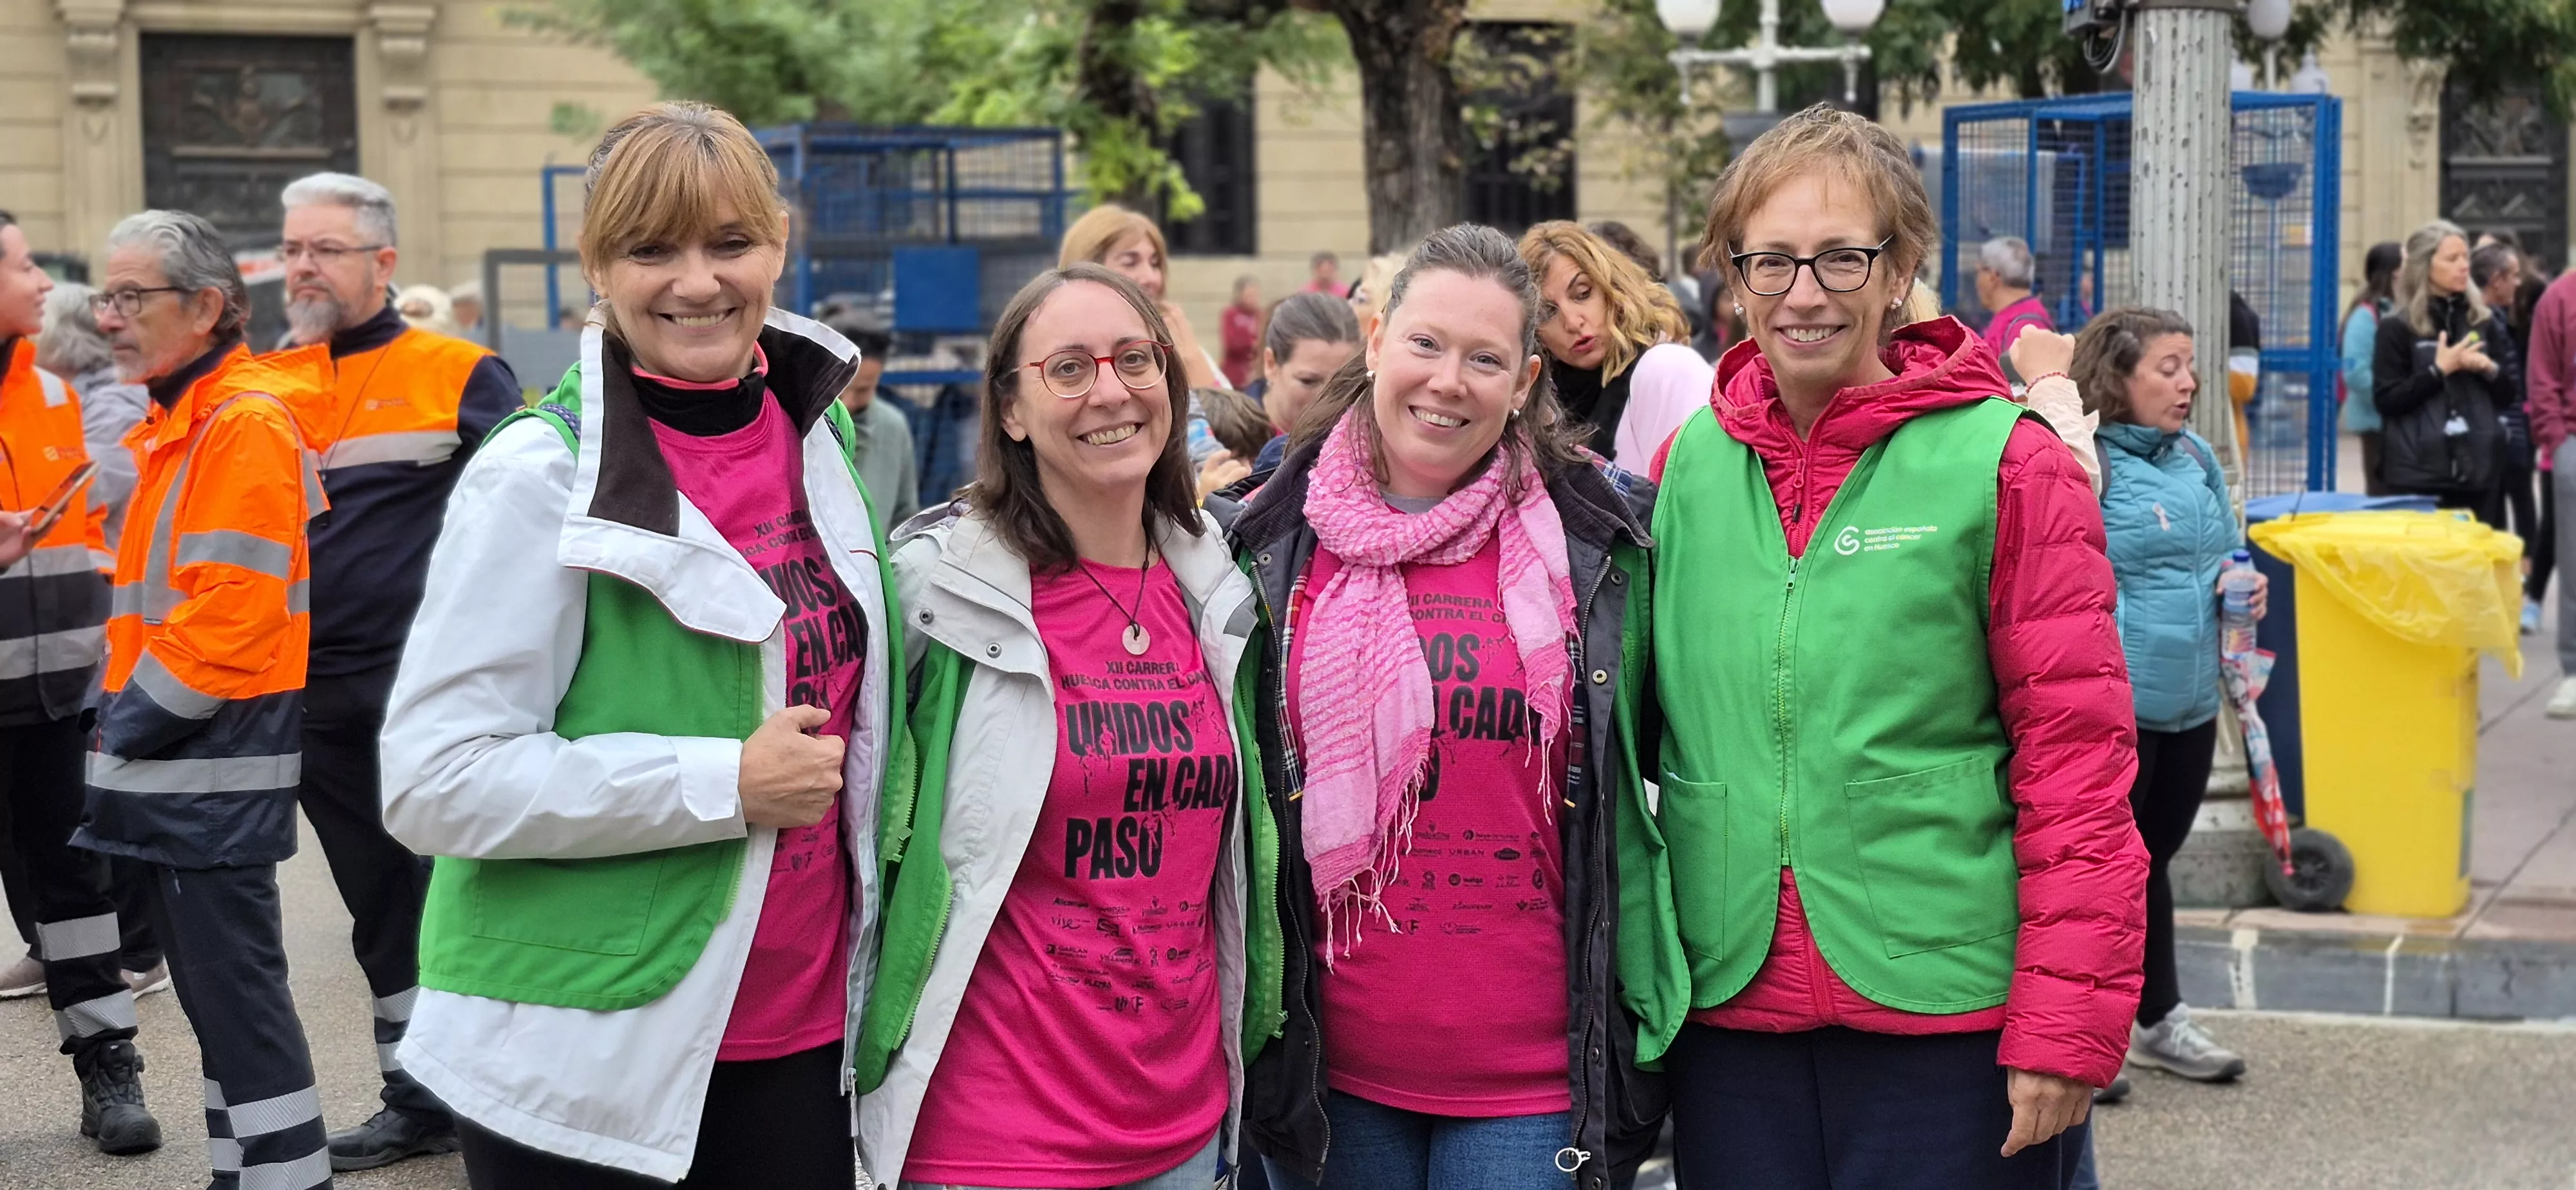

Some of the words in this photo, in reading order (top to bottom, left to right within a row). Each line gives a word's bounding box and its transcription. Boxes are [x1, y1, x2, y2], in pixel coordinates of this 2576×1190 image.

[1423, 593, 1493, 609] CARRERA
[1470, 611, 1487, 621] EL
[788, 616, 829, 678] EN
[1106, 661, 1124, 674] XII
[1113, 677, 1166, 690] CONTRA
[1167, 676, 1185, 690] EL
[1066, 700, 1194, 756] UNIDOS
[1125, 758, 1168, 813] EN
[1065, 817, 1162, 879] PASO
